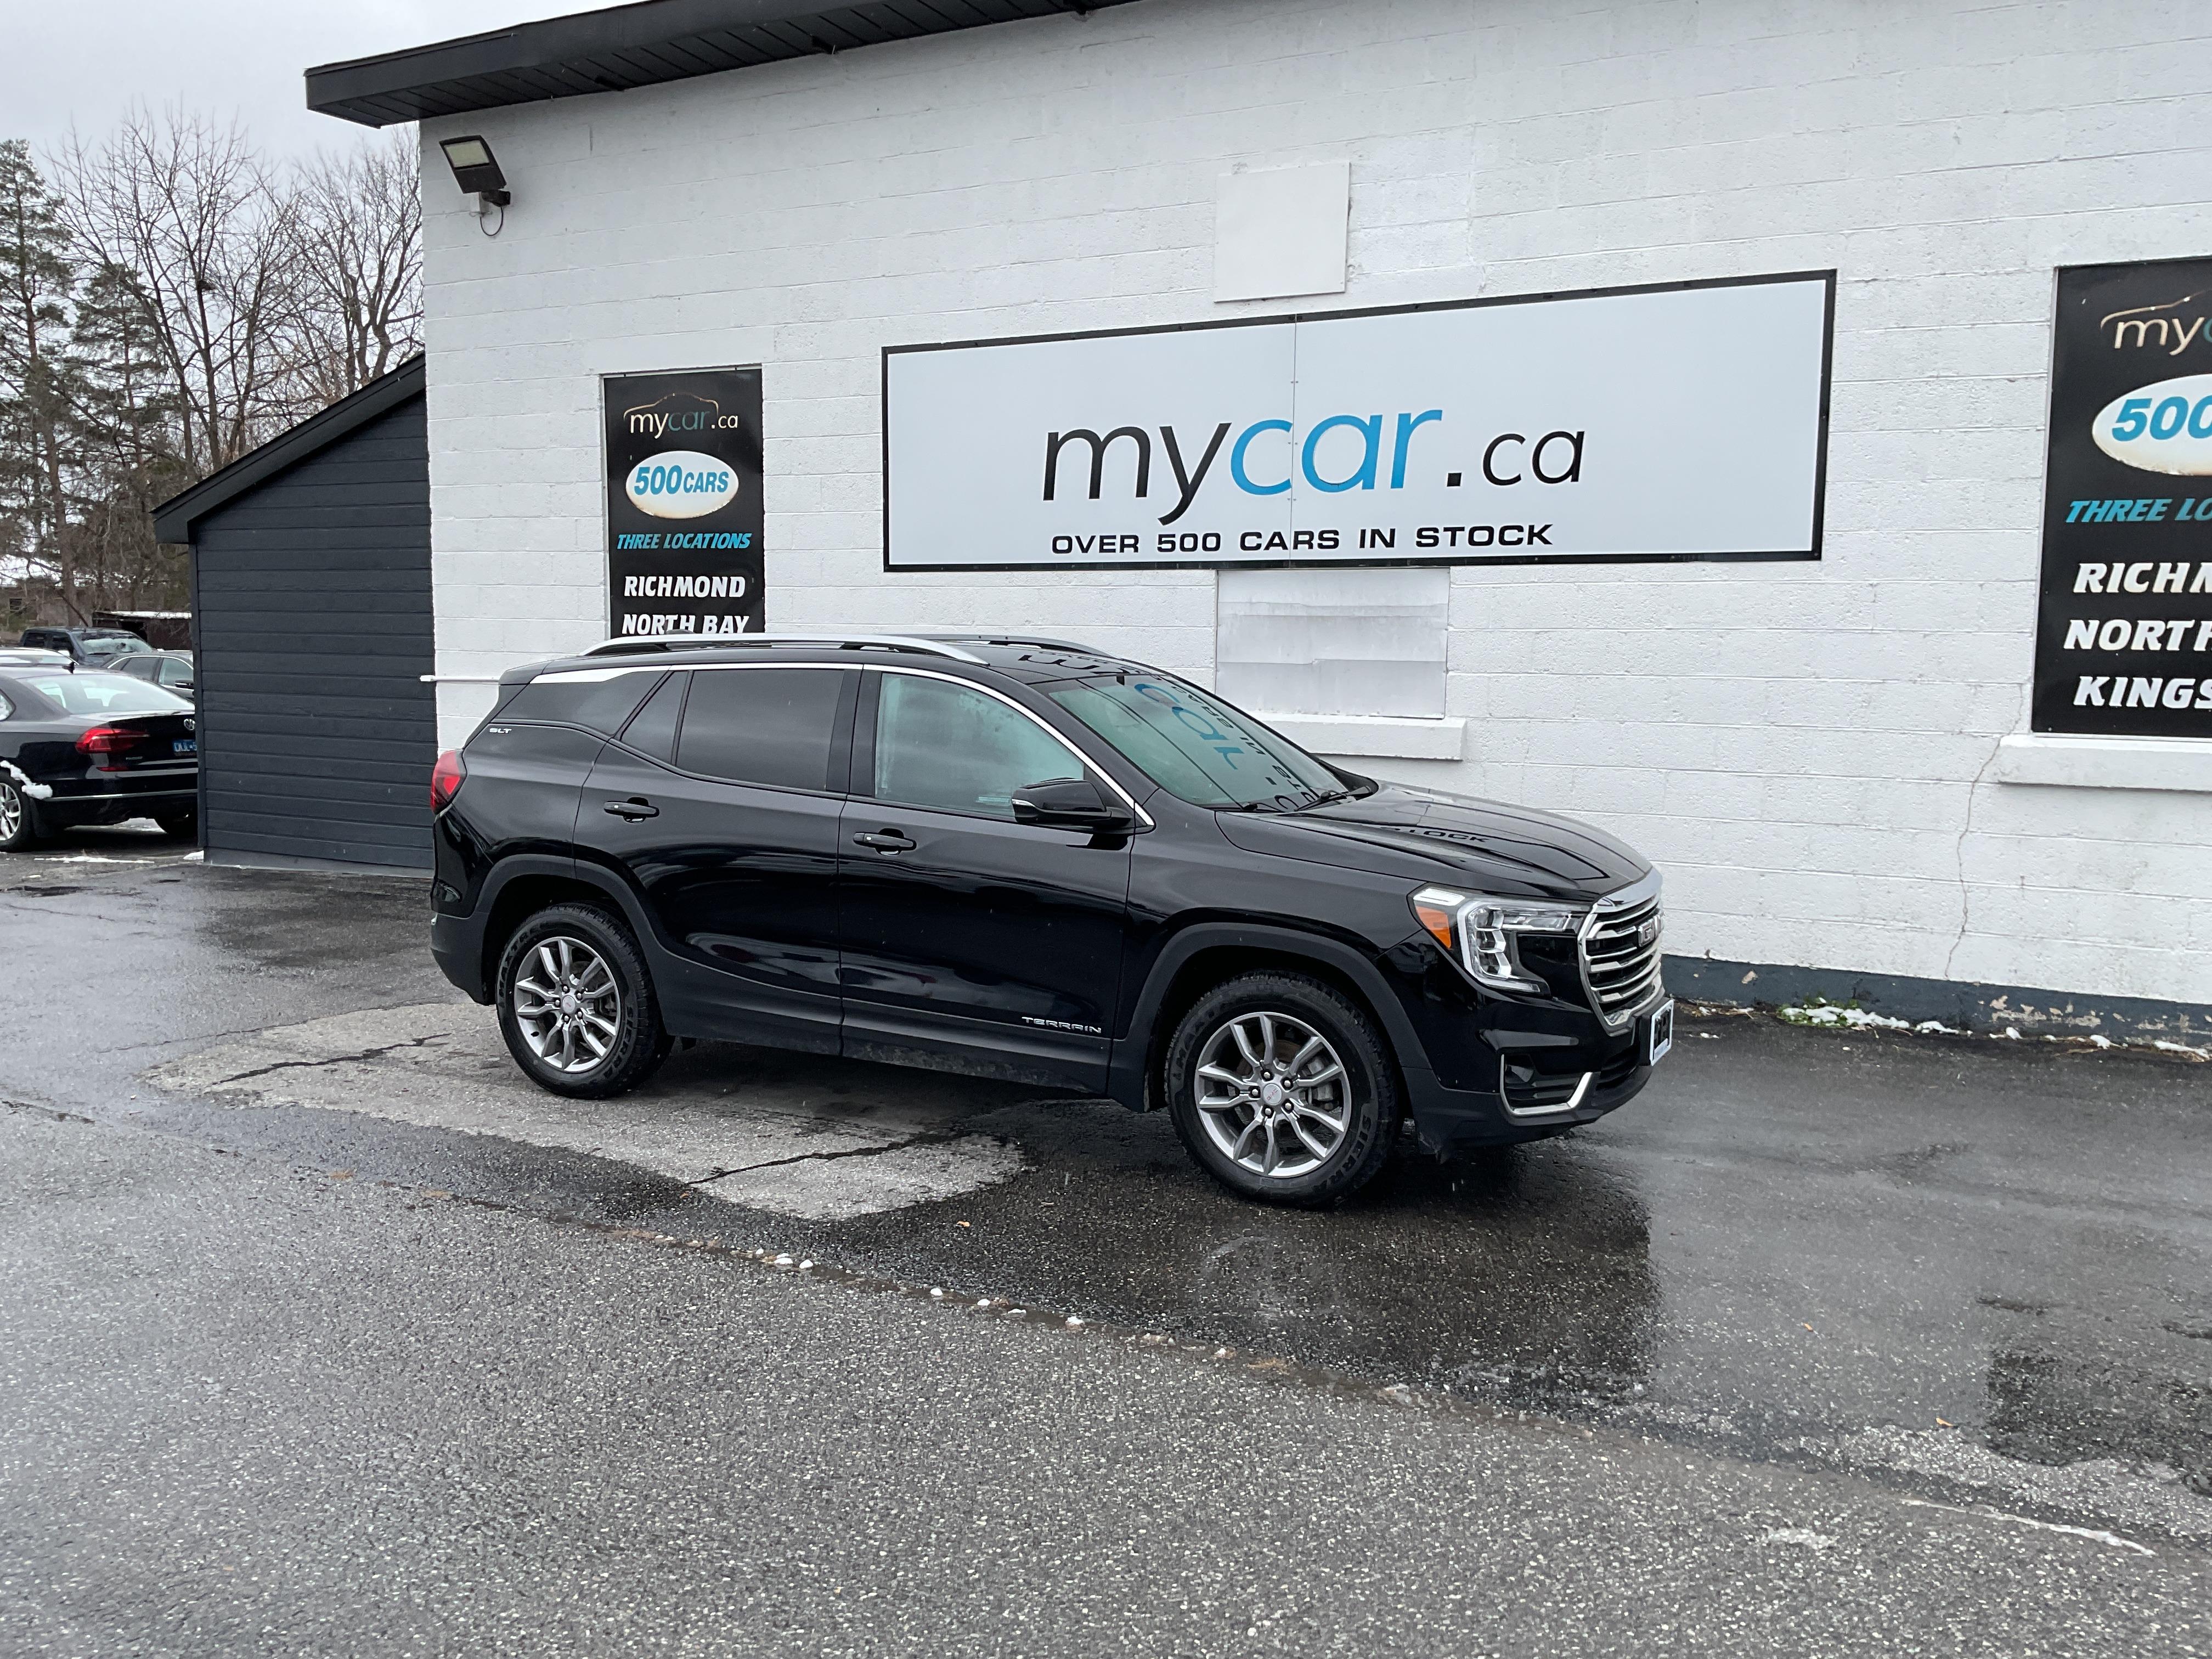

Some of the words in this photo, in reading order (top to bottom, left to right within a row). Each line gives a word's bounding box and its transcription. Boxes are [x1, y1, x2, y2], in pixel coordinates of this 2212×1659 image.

[2112, 395, 2212, 442] 500
[634, 465, 682, 495] 500
[683, 471, 729, 493] CARS
[2066, 499, 2172, 523] THREE
[617, 534, 662, 549] THREE
[663, 533, 752, 549] LOCATIONS
[1052, 534, 1139, 554] OVER
[1157, 532, 1222, 552] 500
[1239, 529, 1339, 550] CARS
[1359, 528, 1396, 548] IN
[1415, 523, 1553, 548] STOCK
[624, 576, 746, 597] RICHMOND
[622, 614, 695, 635] NORTH
[703, 616, 749, 634] BAY
[1022, 1017, 1101, 1034] TERRAIN
